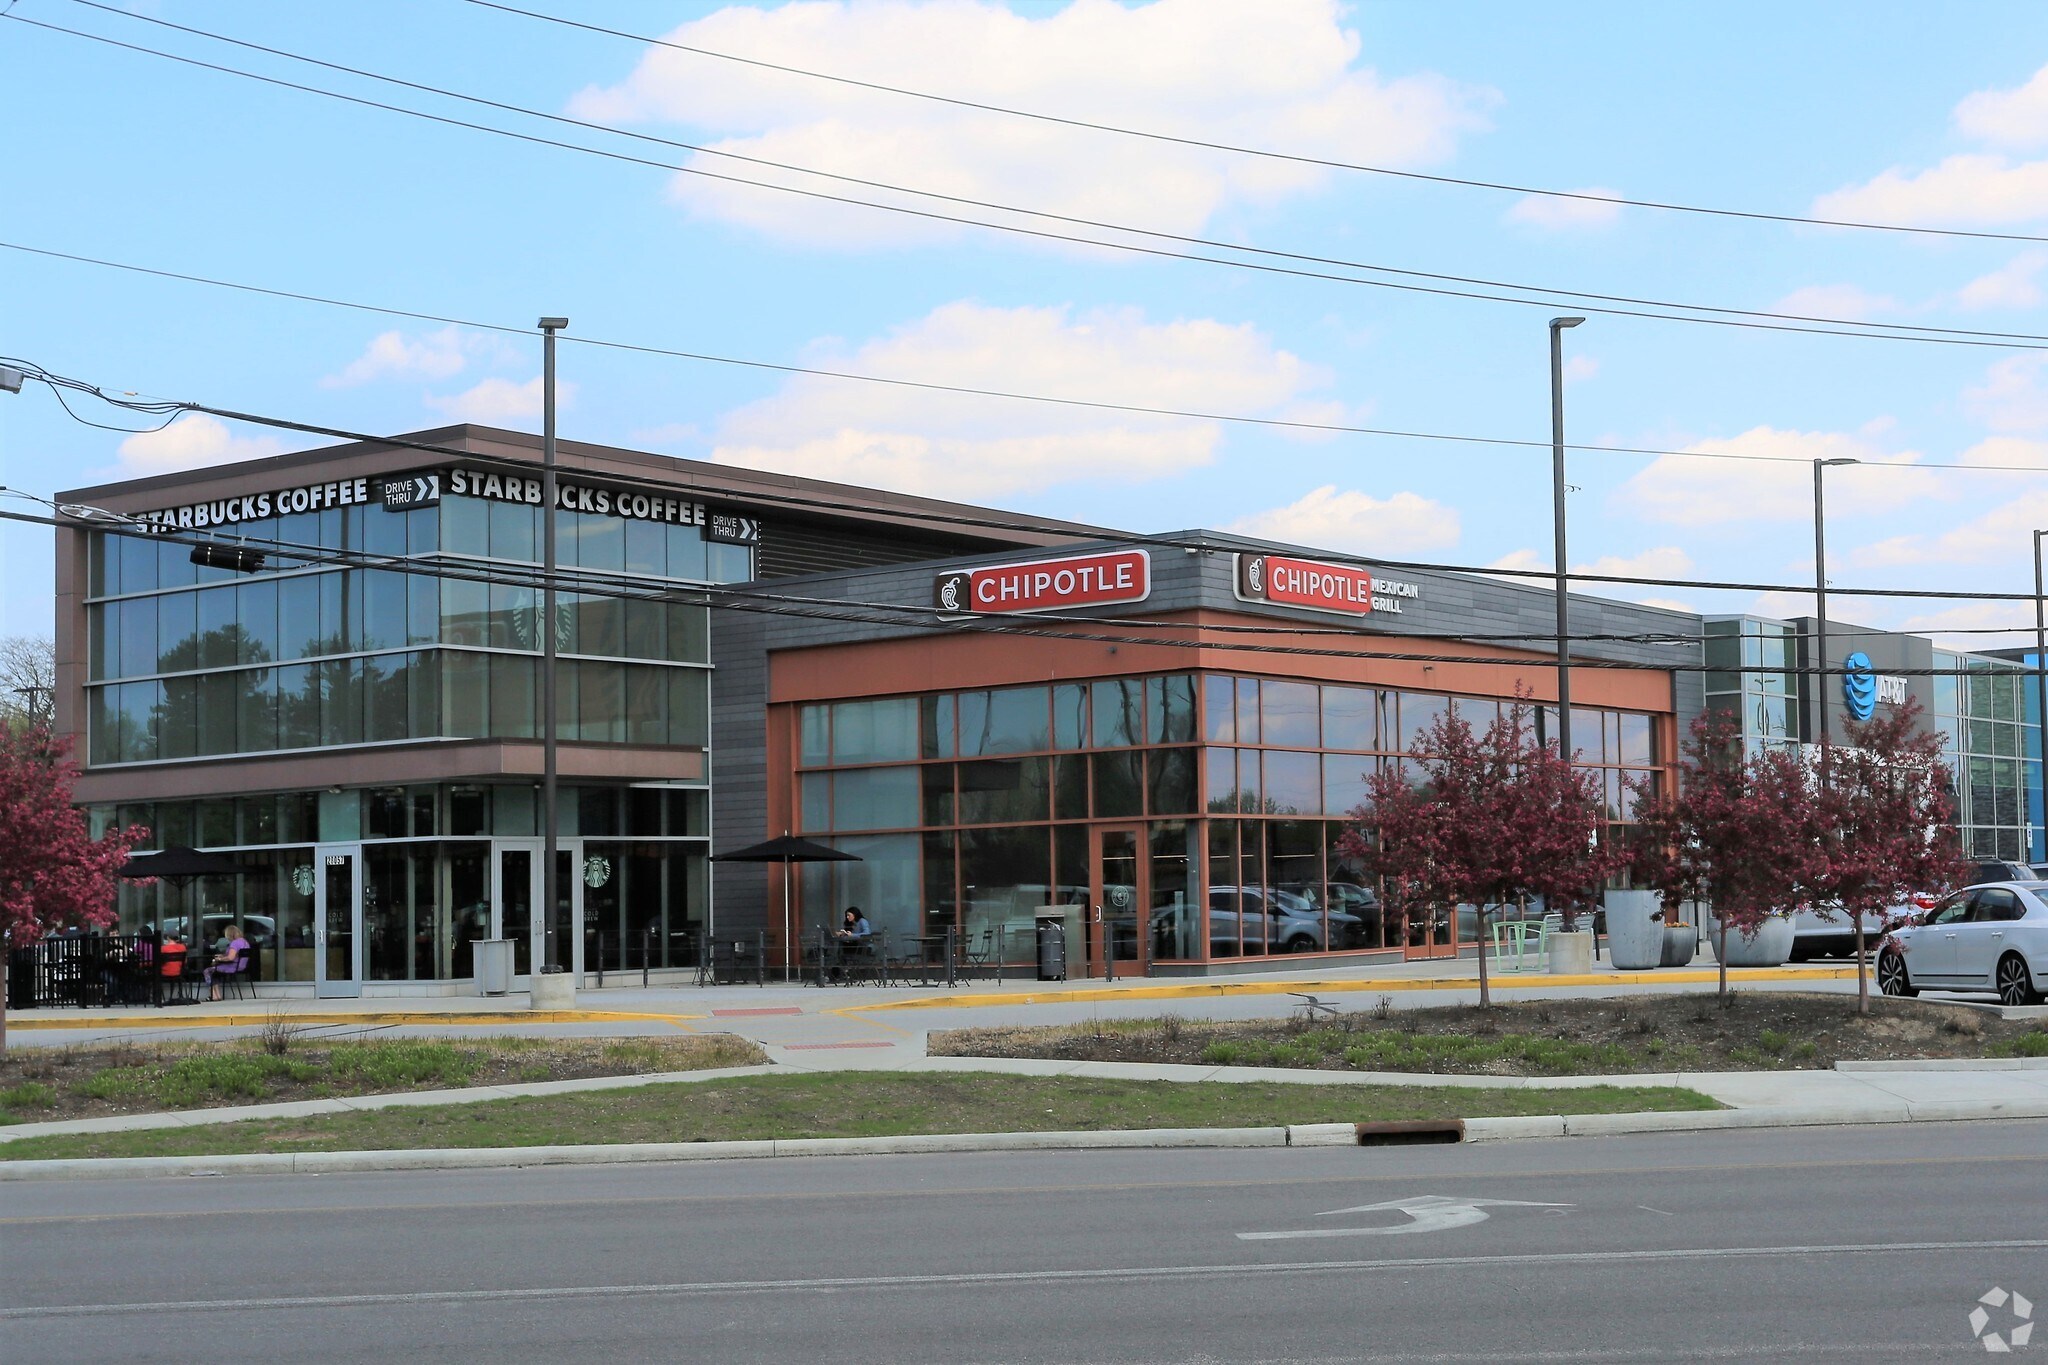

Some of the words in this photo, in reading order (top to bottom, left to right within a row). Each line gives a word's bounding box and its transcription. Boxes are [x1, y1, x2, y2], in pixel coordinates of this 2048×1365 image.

[277, 477, 367, 515] COFFEE
[385, 480, 413, 494] DRIVE
[385, 491, 411, 506] THRU
[617, 493, 706, 527] COFFEE
[712, 514, 737, 528] DRIVE
[713, 525, 736, 538] THRU
[977, 562, 1134, 604] CHIPOTLE
[1272, 566, 1368, 604] CHIPOTLE
[1370, 578, 1419, 599] MEXICAN
[1371, 596, 1403, 614] GRILL
[1875, 674, 1908, 705] AT&T
